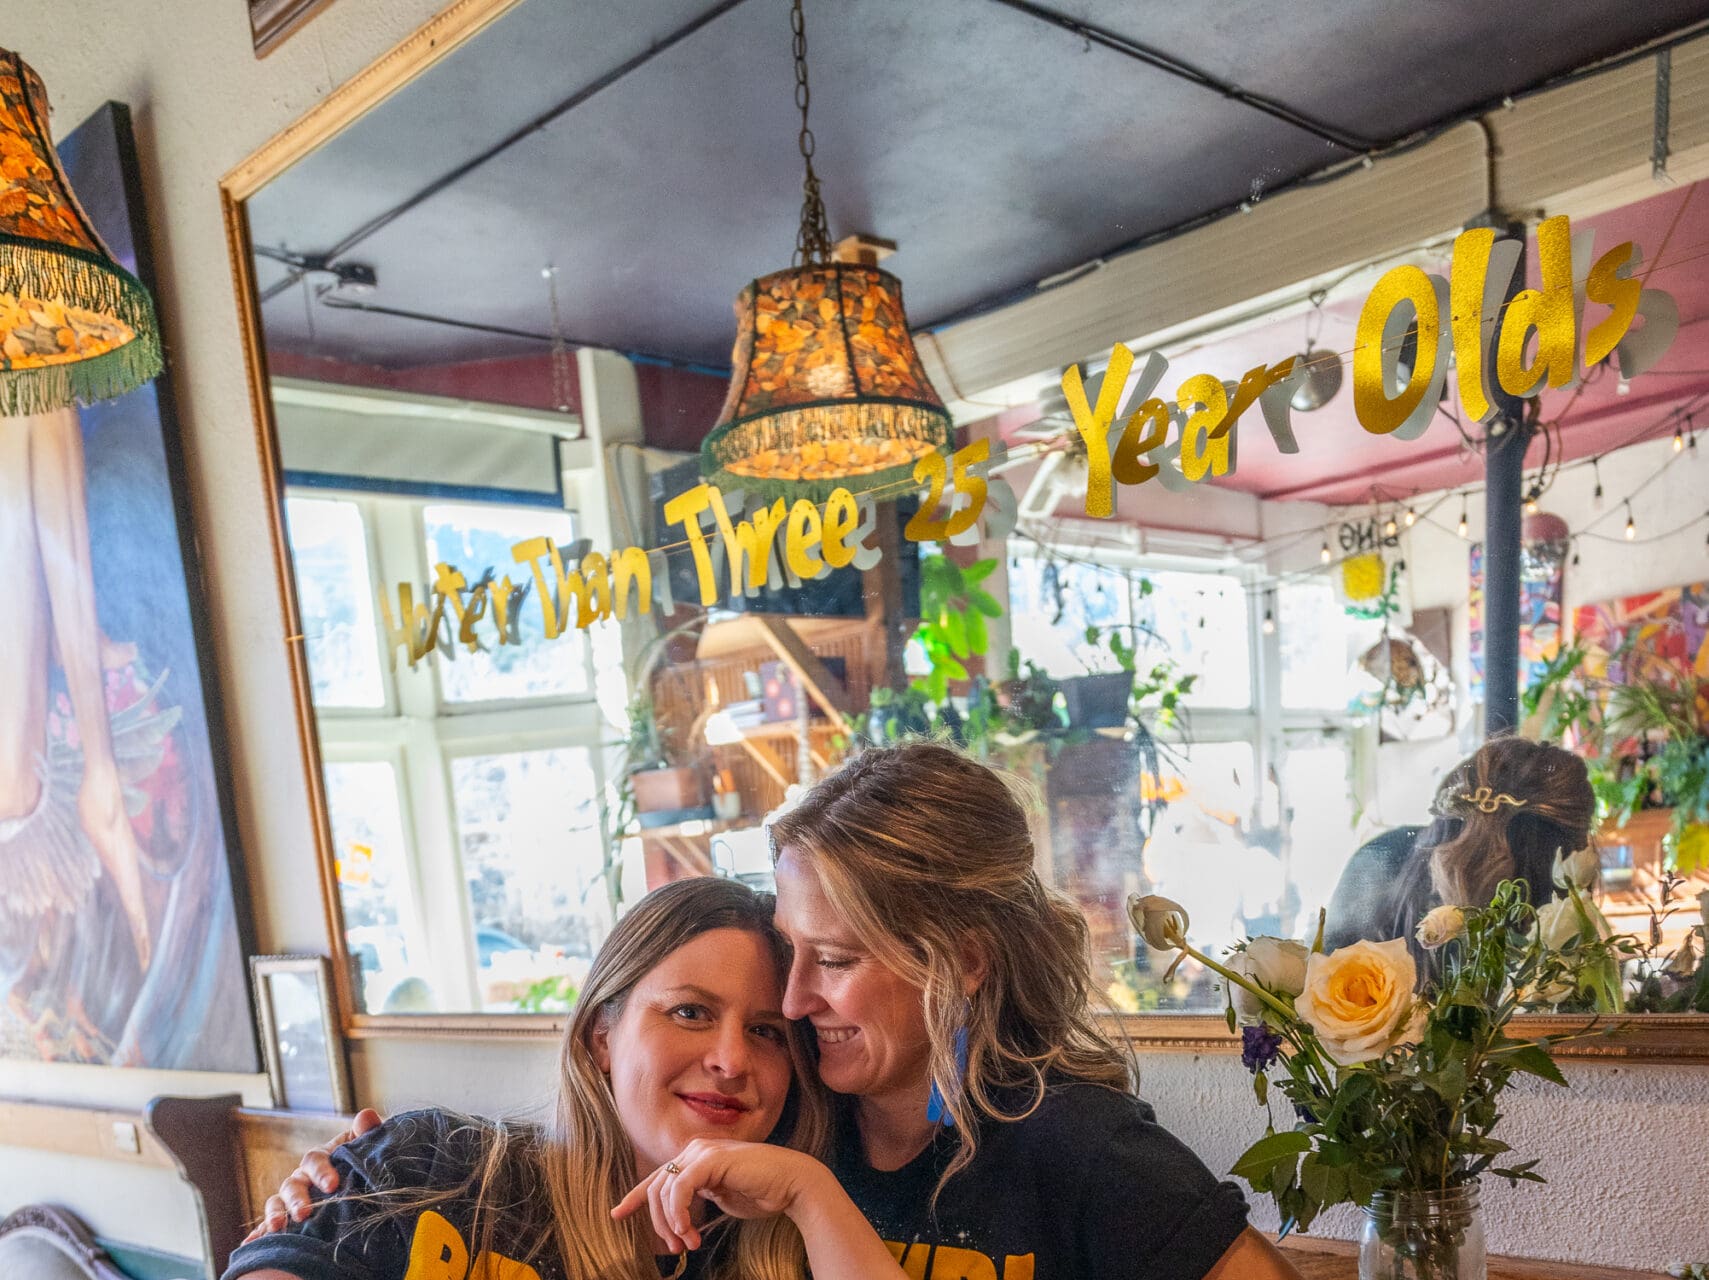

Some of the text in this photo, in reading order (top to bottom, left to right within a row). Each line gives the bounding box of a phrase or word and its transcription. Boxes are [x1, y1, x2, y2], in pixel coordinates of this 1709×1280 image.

[511, 536, 652, 640] Than
[663, 484, 858, 607] Three
[904, 437, 990, 542] 25
[1061, 342, 1299, 519] Year
[1353, 214, 1642, 435] Olds
